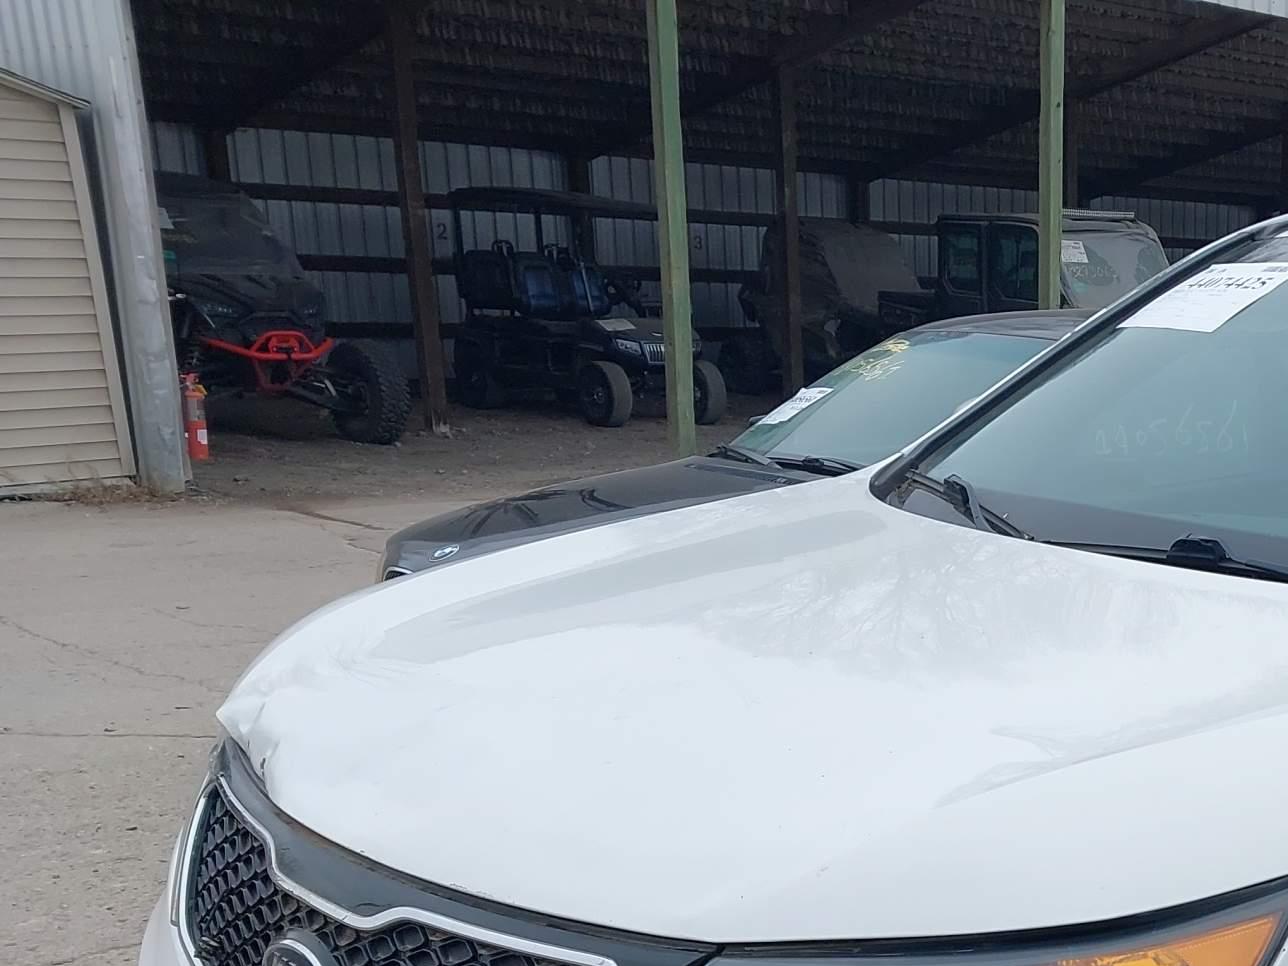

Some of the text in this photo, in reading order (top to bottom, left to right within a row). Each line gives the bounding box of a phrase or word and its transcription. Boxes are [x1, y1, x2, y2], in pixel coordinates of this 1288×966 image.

[437, 223, 448, 240] 2
[694, 235, 703, 249] 3
[1187, 276, 1275, 290] 44074425
